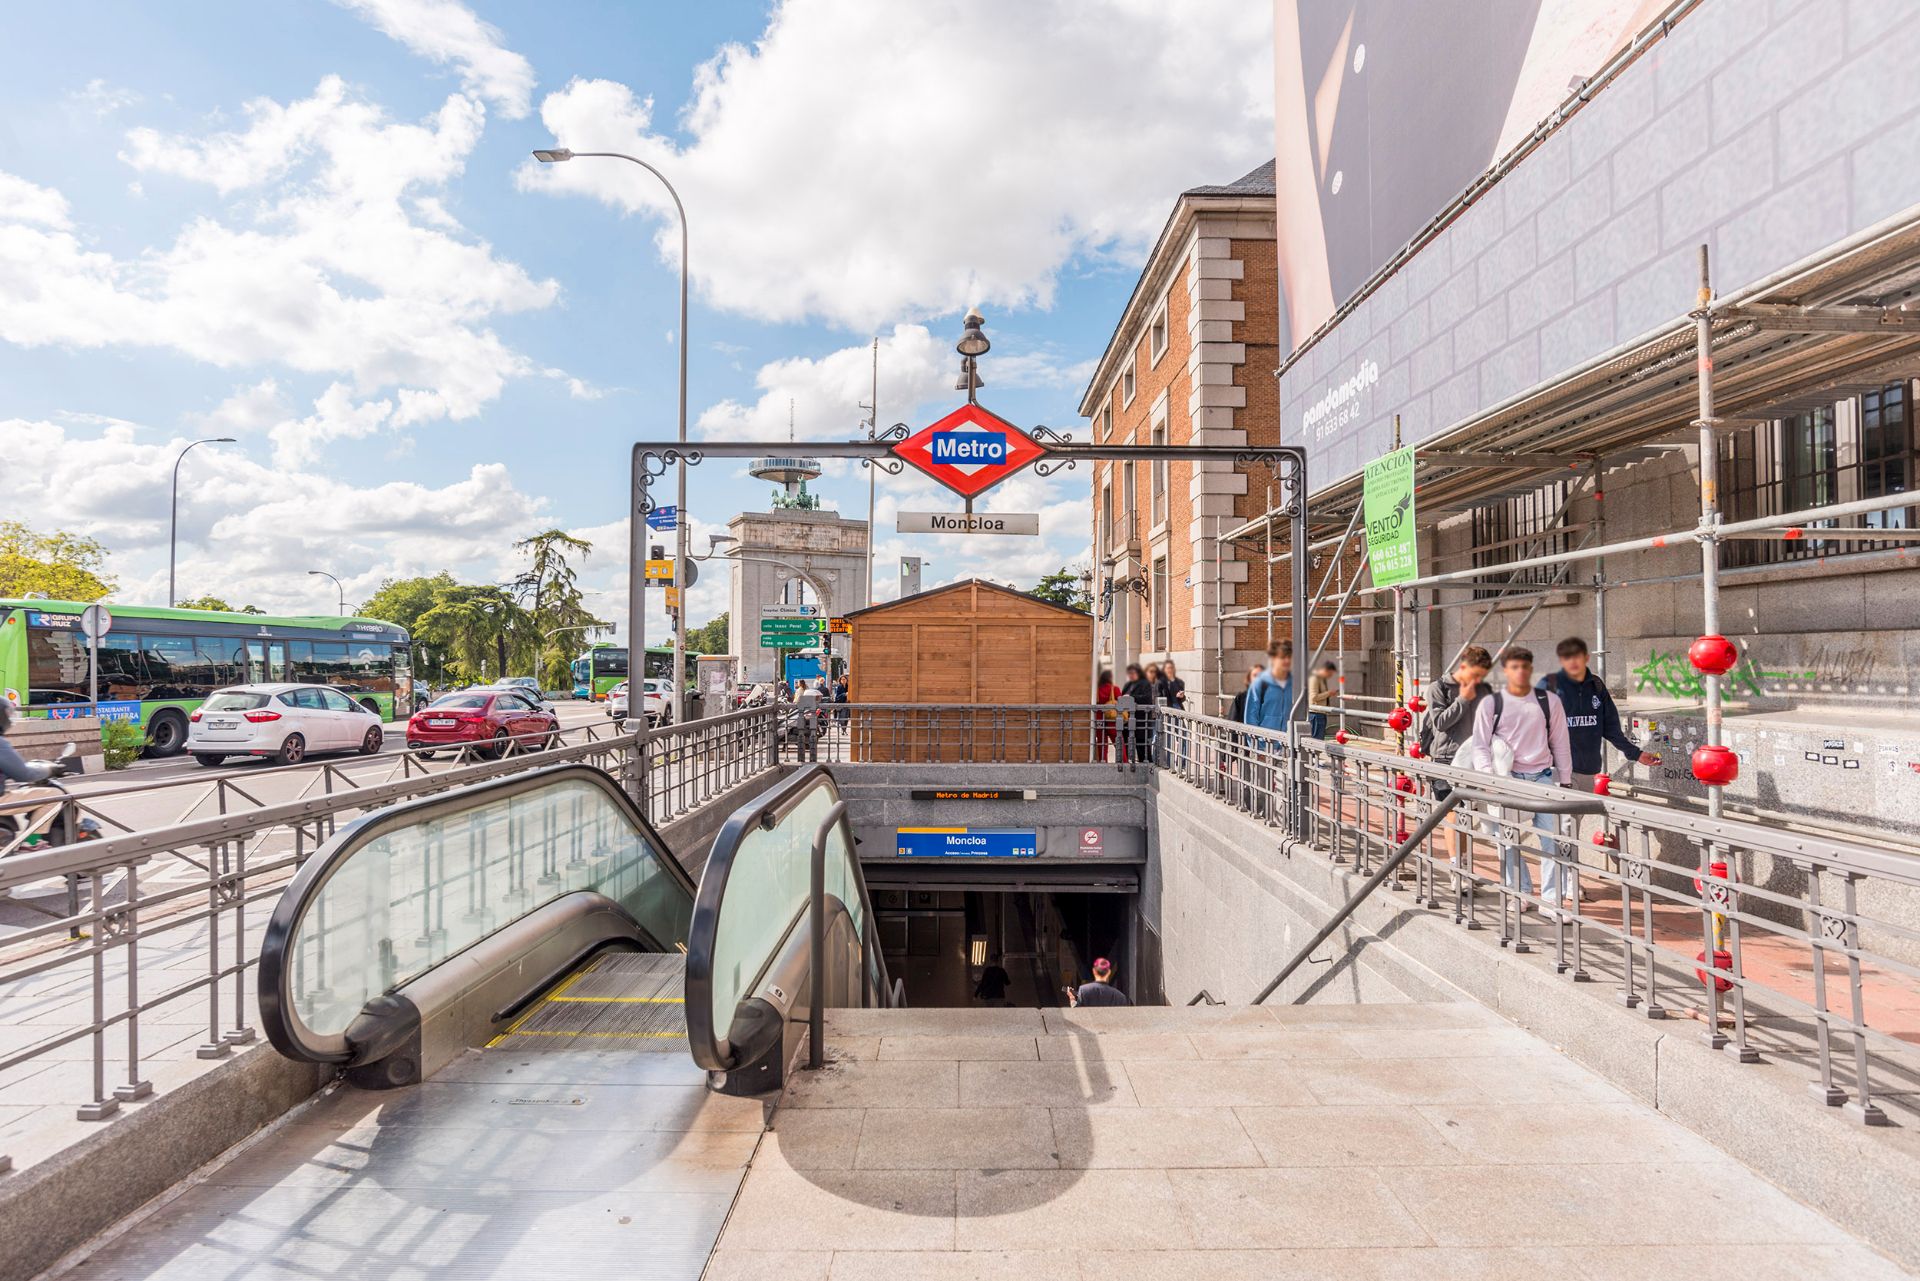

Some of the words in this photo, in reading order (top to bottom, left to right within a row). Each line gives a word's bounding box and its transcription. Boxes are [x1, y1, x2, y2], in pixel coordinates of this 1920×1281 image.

[937, 438, 1002, 458] Metro
[1364, 449, 1412, 480] ATENCIÓN
[931, 515, 1005, 531] Moncloa
[1366, 514, 1399, 536] VENTO
[1368, 529, 1400, 547] SEGURIDAD
[52, 614, 81, 622] GRUPO
[946, 836, 987, 846] Moncloa
